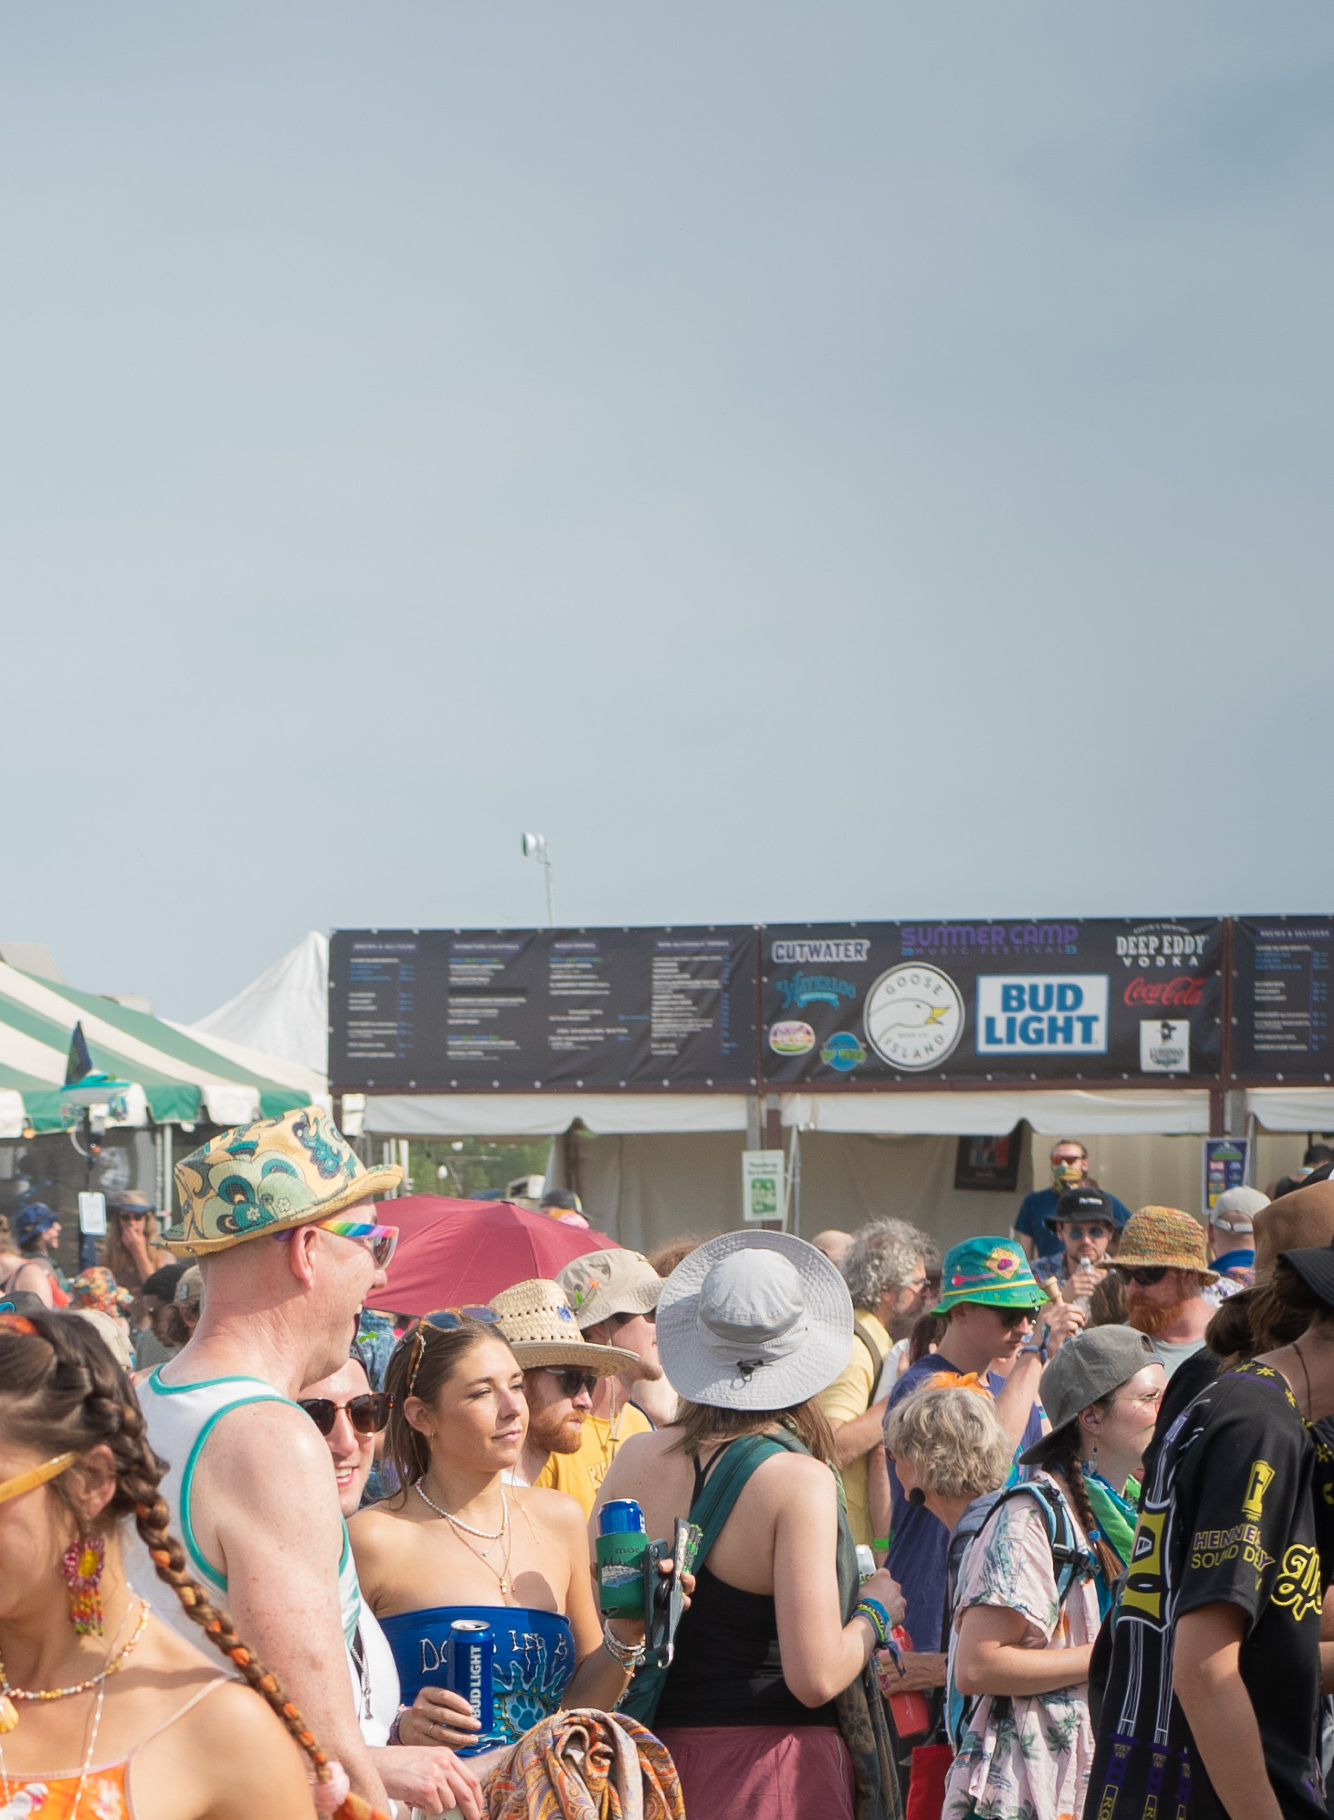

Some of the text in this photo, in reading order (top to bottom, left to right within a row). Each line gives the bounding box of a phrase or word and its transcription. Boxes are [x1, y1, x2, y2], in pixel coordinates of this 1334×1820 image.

[1010, 925, 1078, 945] CAMP
[1116, 935, 1206, 956] DEEP EDDY
[773, 941, 868, 962] CUTWATER
[1122, 956, 1199, 968] VODKA
[885, 973, 944, 997] GOOSE
[1001, 983, 1084, 1013] BUD
[984, 1015, 1099, 1046] LIGHT
[883, 1034, 946, 1060] ISLAND
[470, 1645, 482, 1719] BUD LIGHT
